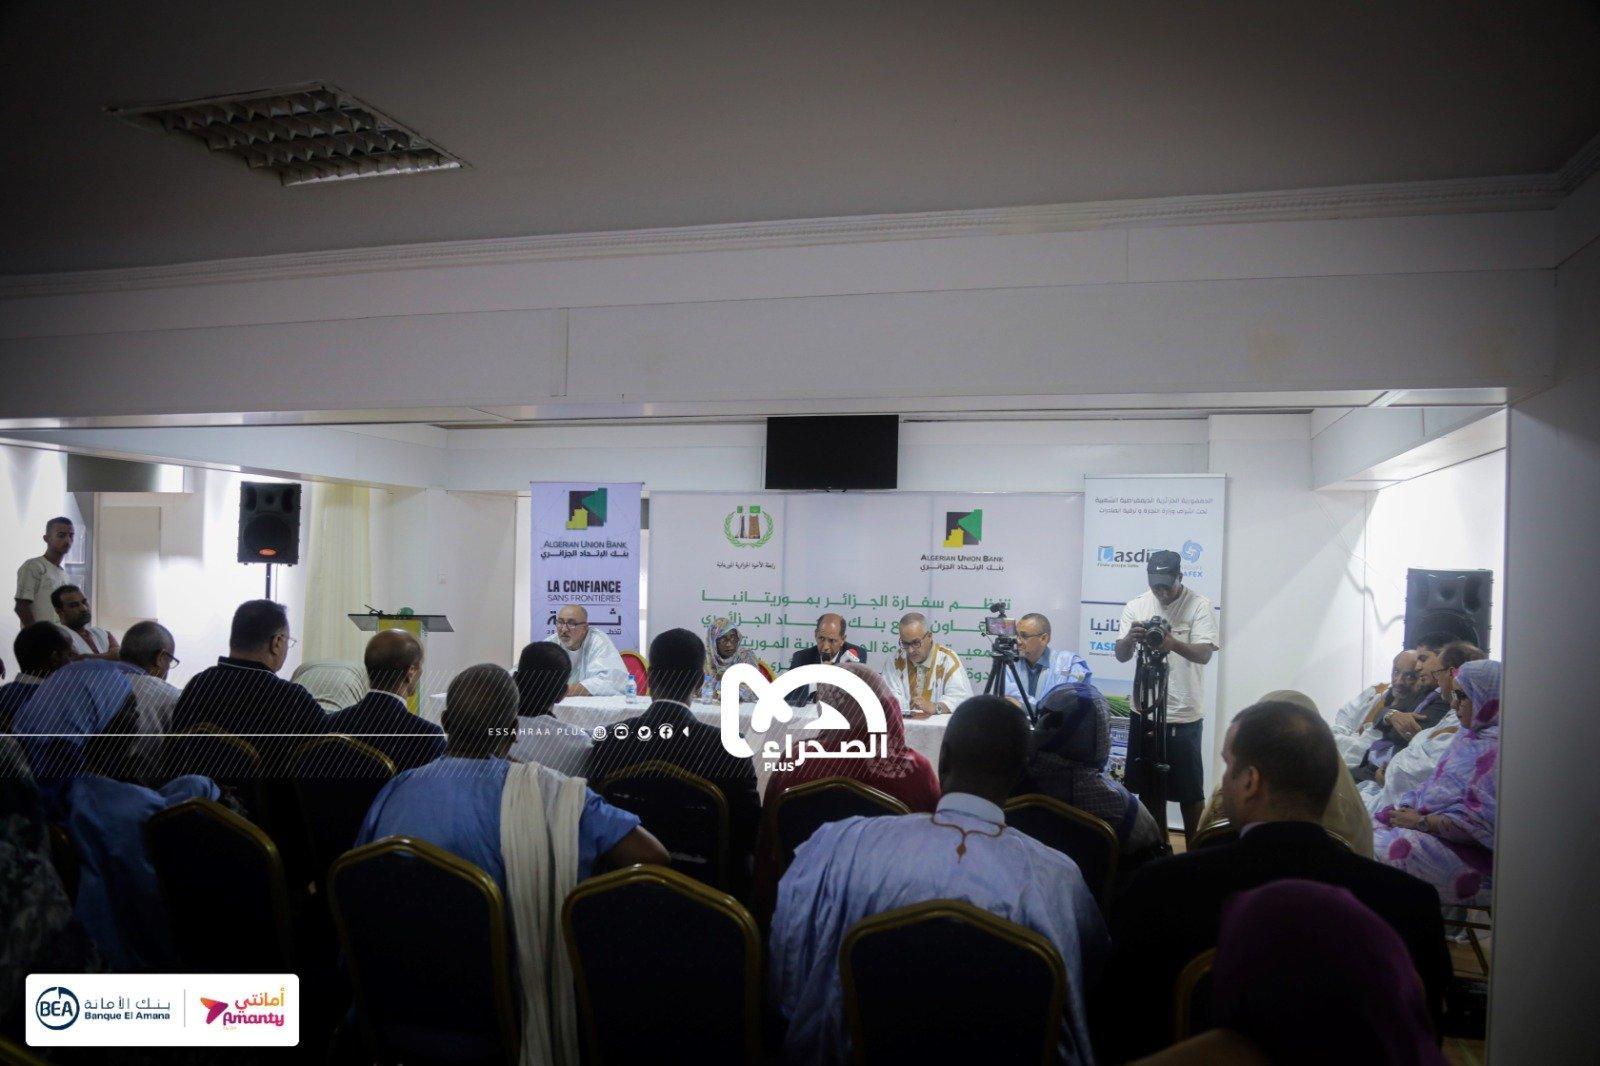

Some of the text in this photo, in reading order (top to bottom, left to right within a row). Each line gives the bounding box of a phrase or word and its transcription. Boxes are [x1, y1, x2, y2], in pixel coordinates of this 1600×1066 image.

[543, 540, 579, 548] ALGERIAN
[920, 554, 956, 562] ALGERIAN
[547, 580, 621, 593] LA CONFIANCE
[547, 594, 569, 602] SANS
[701, 589, 821, 608] بموريتانيا
[824, 592, 888, 610] الجزائر
[892, 595, 944, 610] سفارة
[848, 615, 886, 632] بنك
